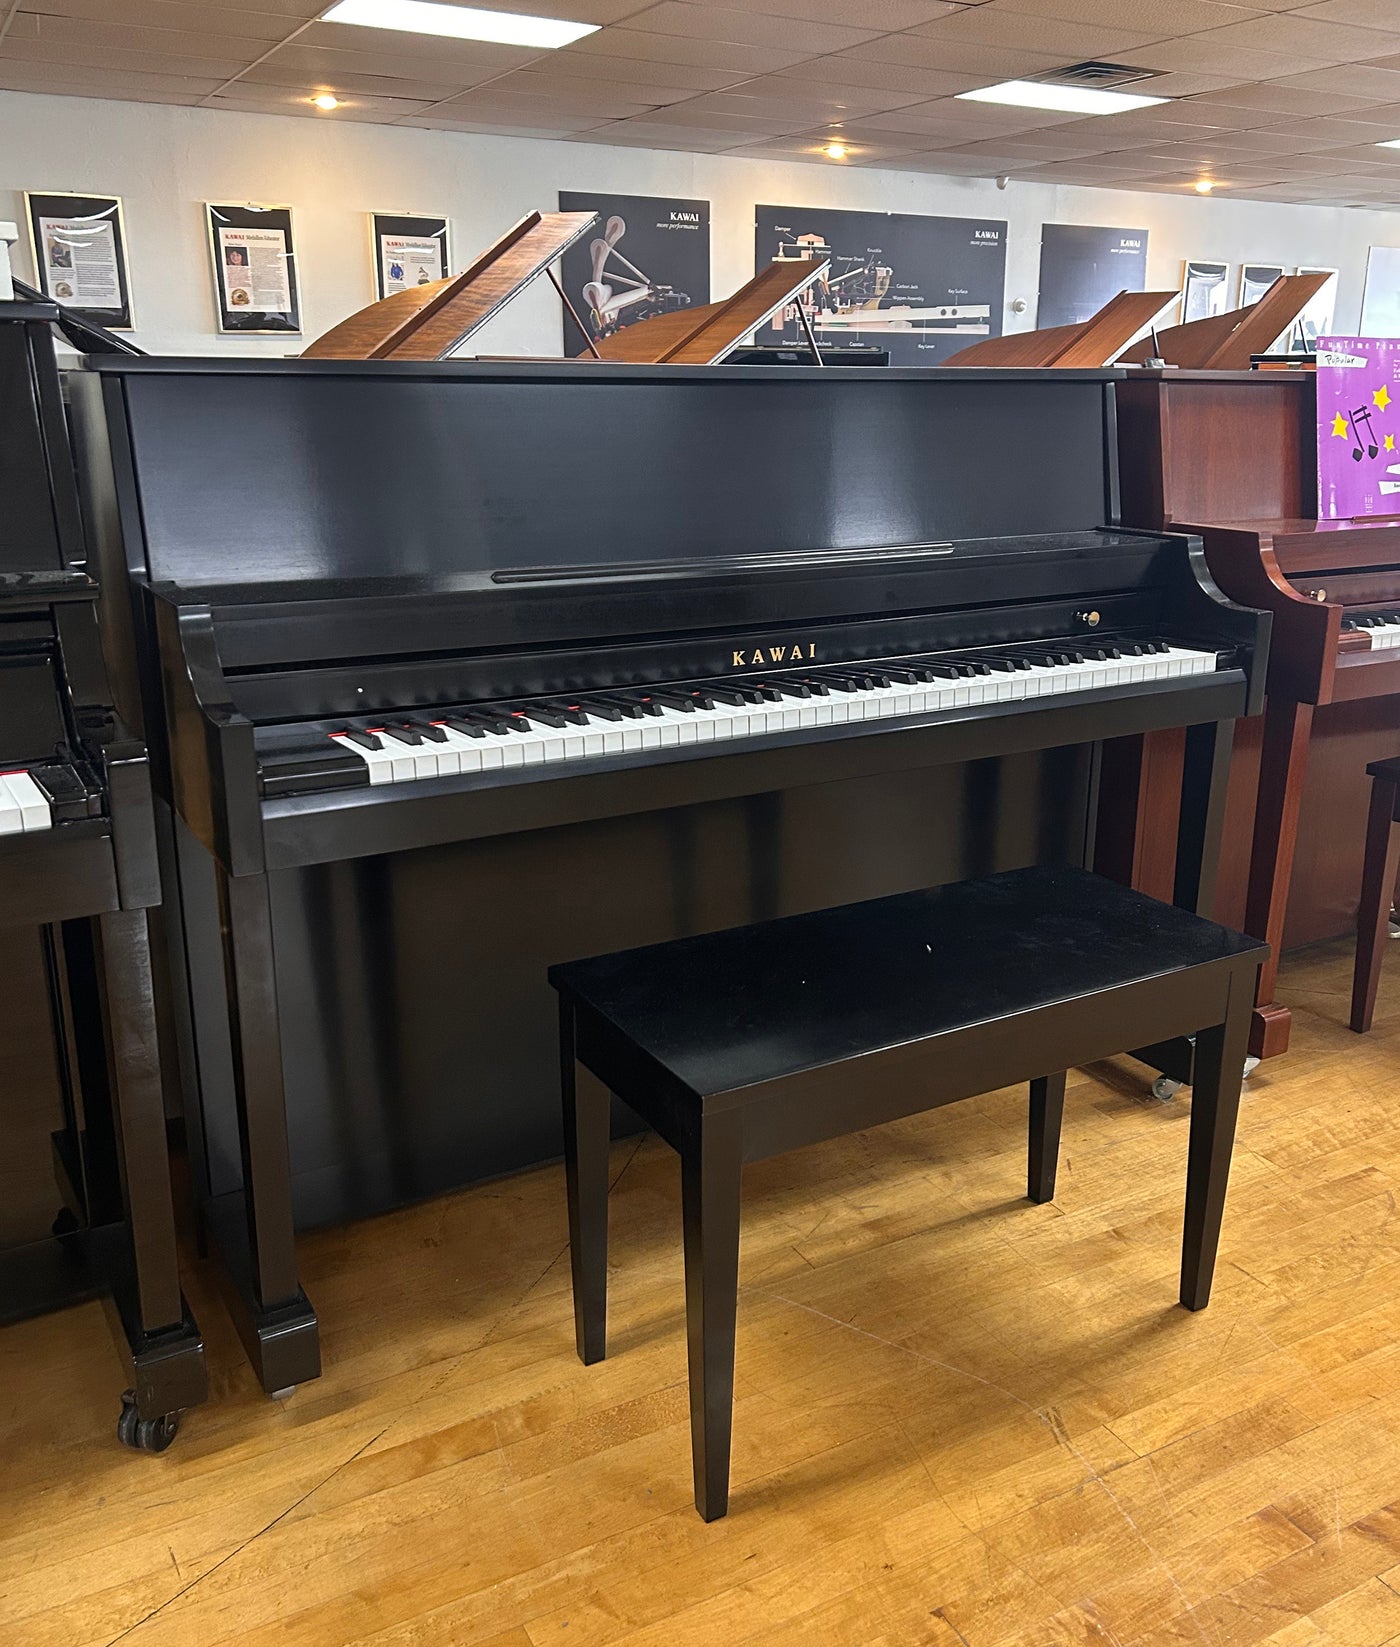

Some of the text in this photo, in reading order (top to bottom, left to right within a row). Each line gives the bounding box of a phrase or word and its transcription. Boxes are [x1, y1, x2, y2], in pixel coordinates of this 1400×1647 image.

[670, 211, 699, 221] KAWAI
[975, 230, 999, 239] KAWAI
[1325, 354, 1355, 365] Popular
[732, 643, 816, 667] KAWAI
